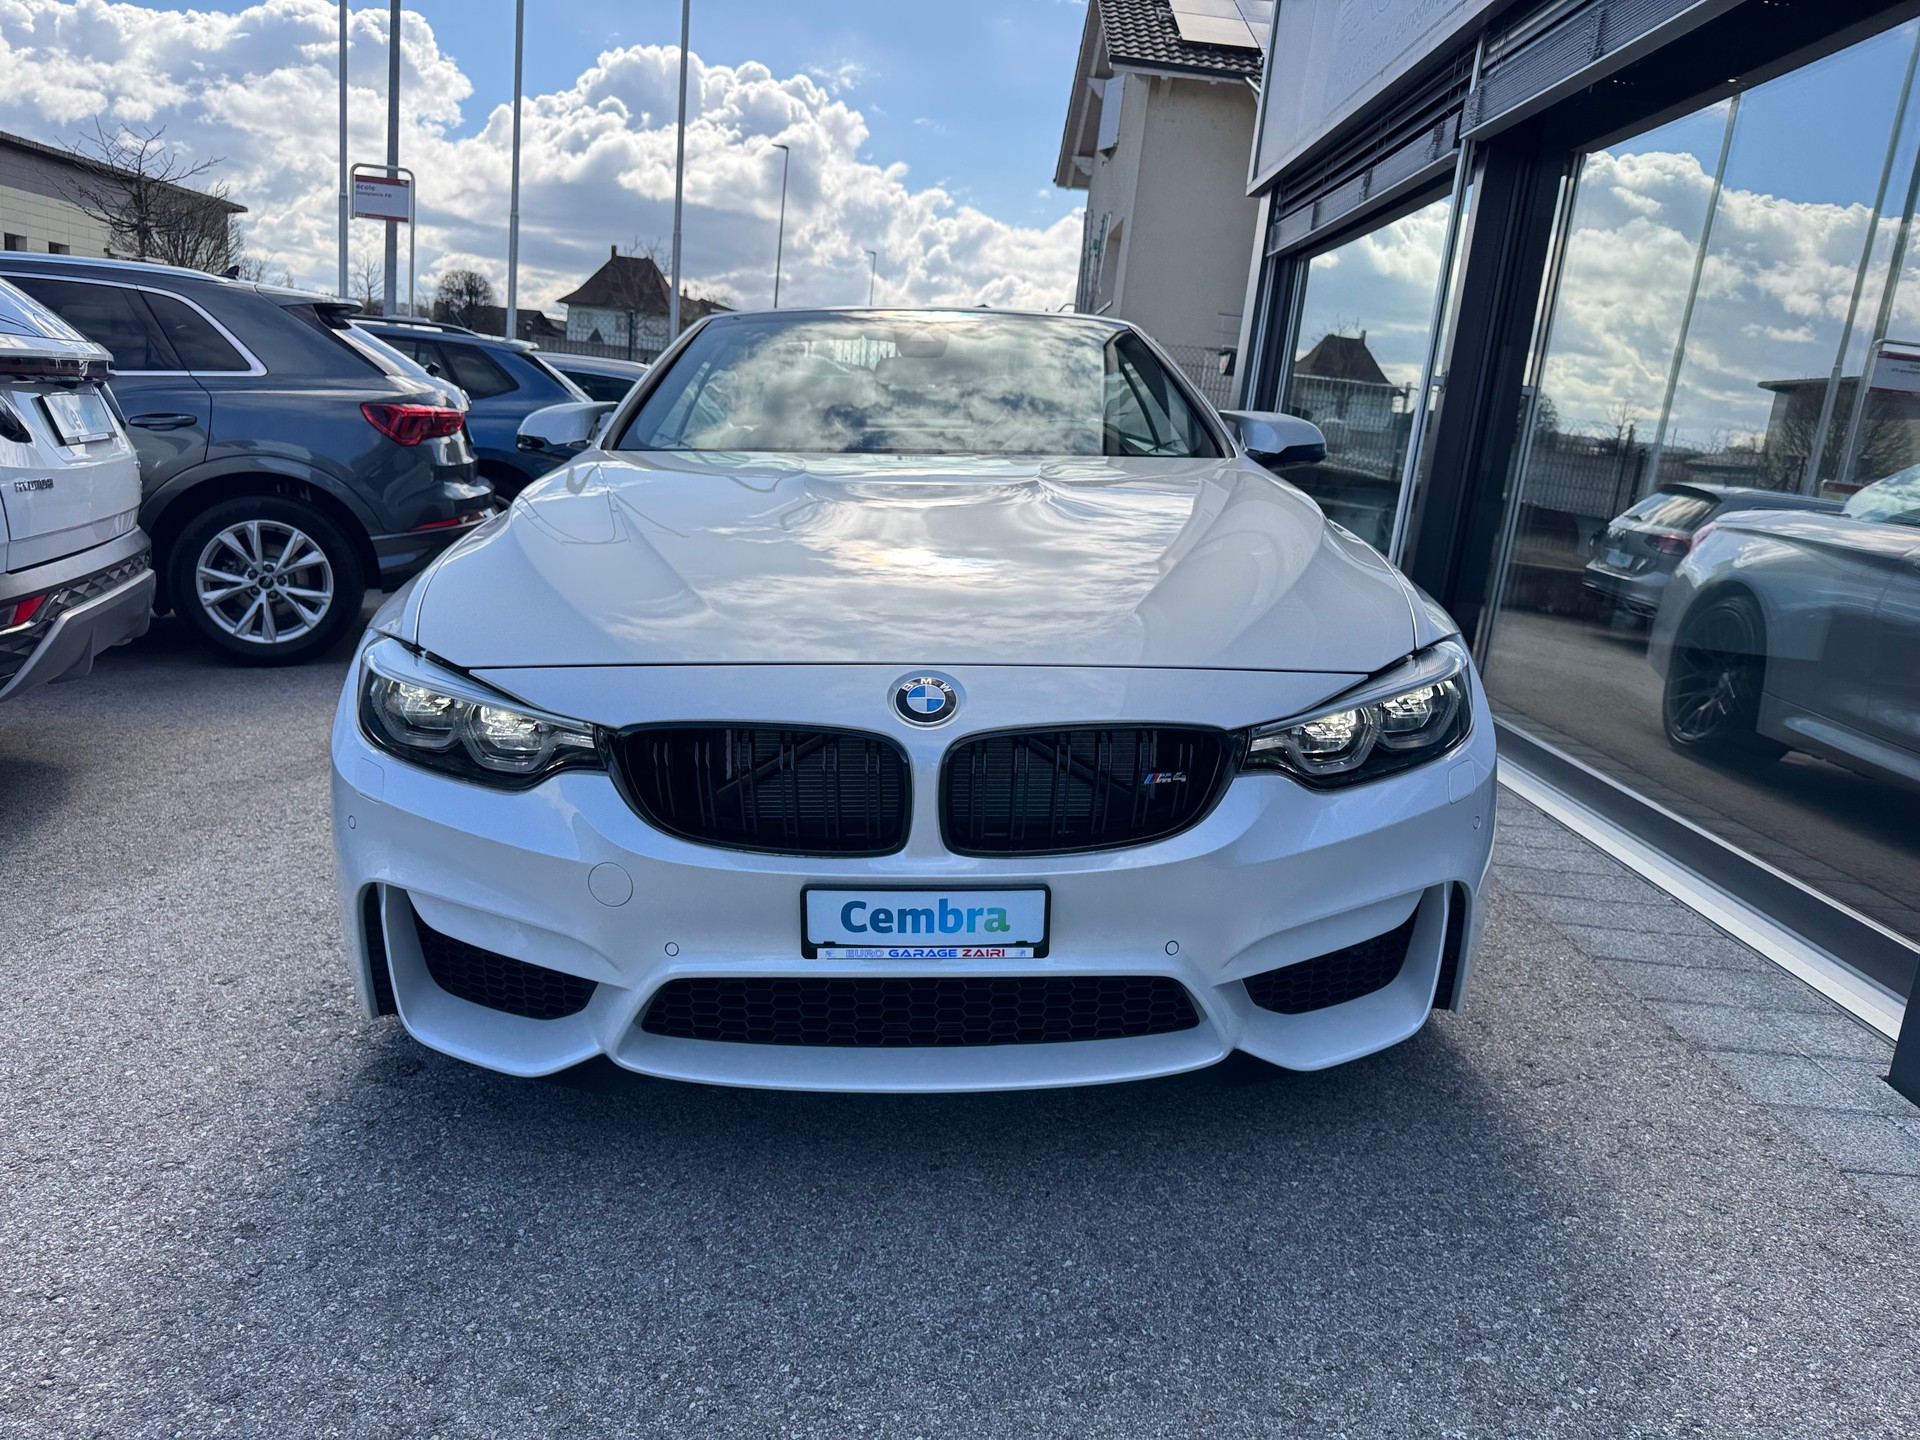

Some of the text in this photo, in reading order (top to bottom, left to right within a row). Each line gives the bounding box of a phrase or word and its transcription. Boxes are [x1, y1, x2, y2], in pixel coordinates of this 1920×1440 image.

[901, 678, 952, 693] BMW
[840, 898, 1011, 934] Cembra
[845, 949, 1006, 958] EURO GARAGE ZAIRI
